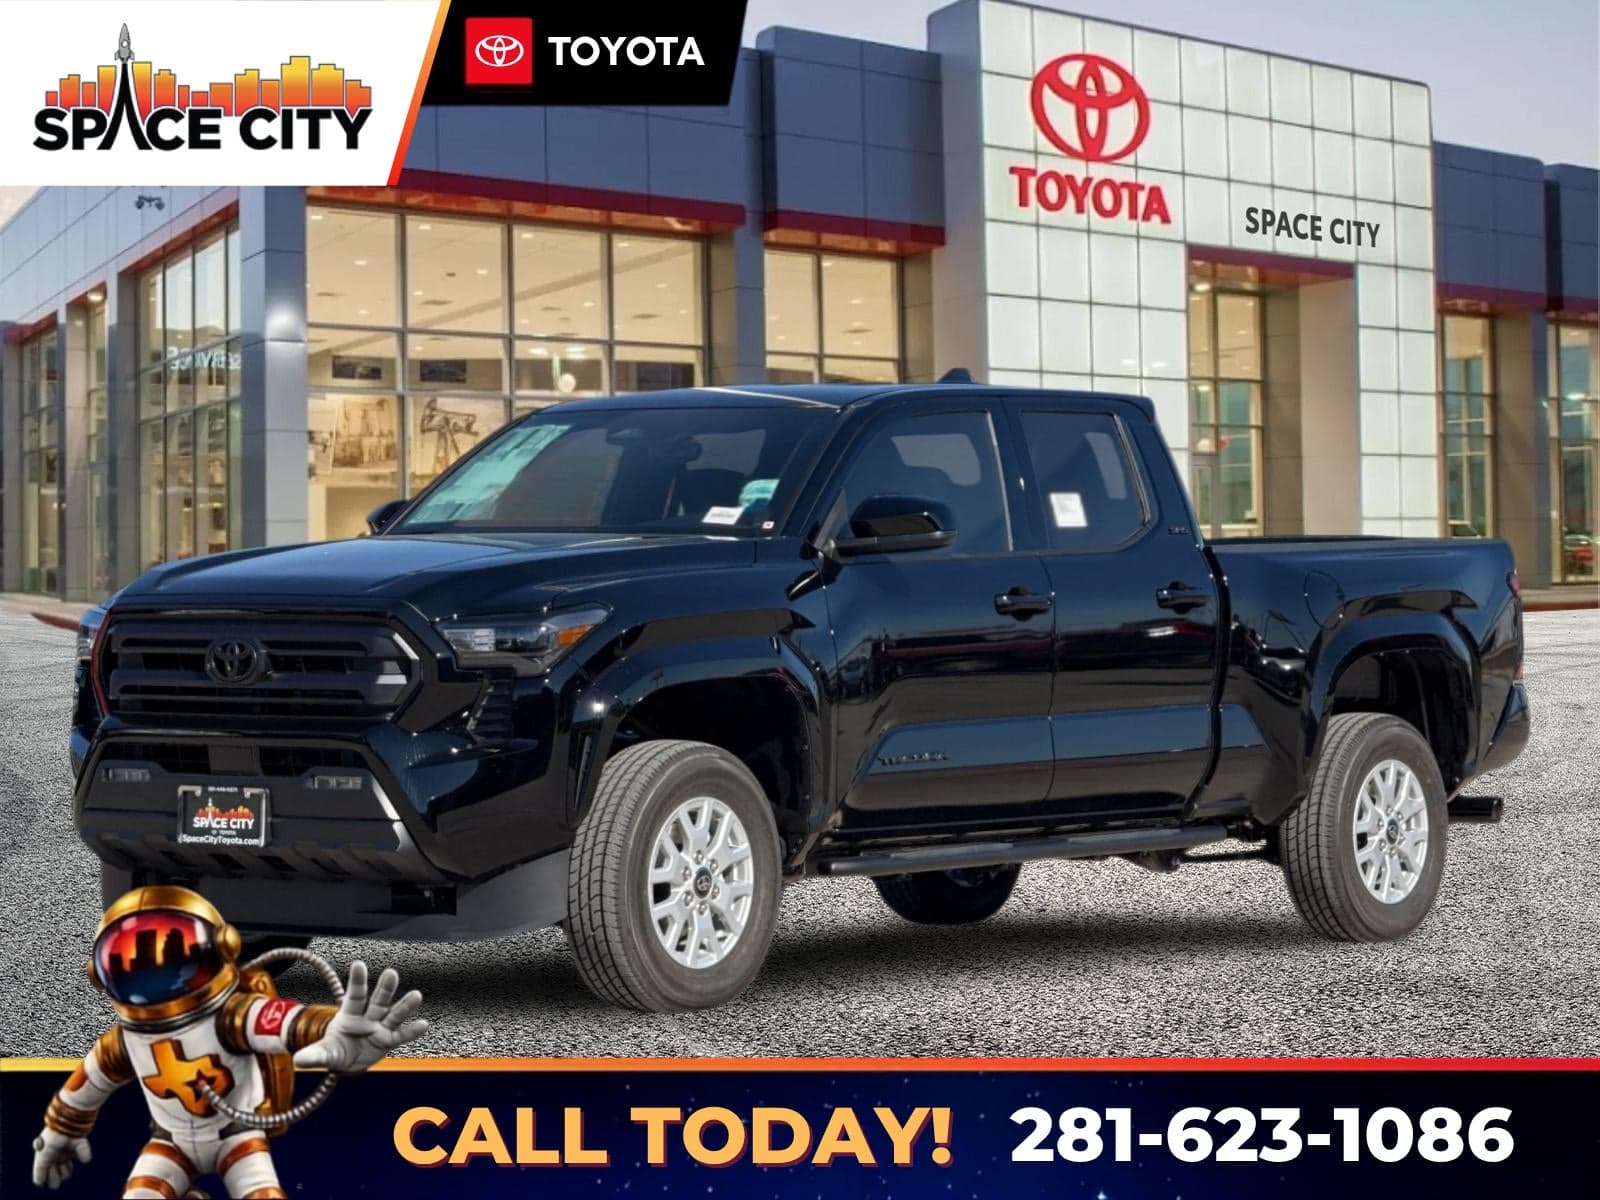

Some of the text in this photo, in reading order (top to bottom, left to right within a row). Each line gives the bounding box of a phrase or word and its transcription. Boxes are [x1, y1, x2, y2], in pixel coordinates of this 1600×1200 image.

[1009, 166, 1171, 224] TOYOTA
[1245, 207, 1380, 247] SPACE CITY
[193, 816, 254, 829] SPACE CITY
[182, 834, 260, 846] SpaceCityToyota.com
